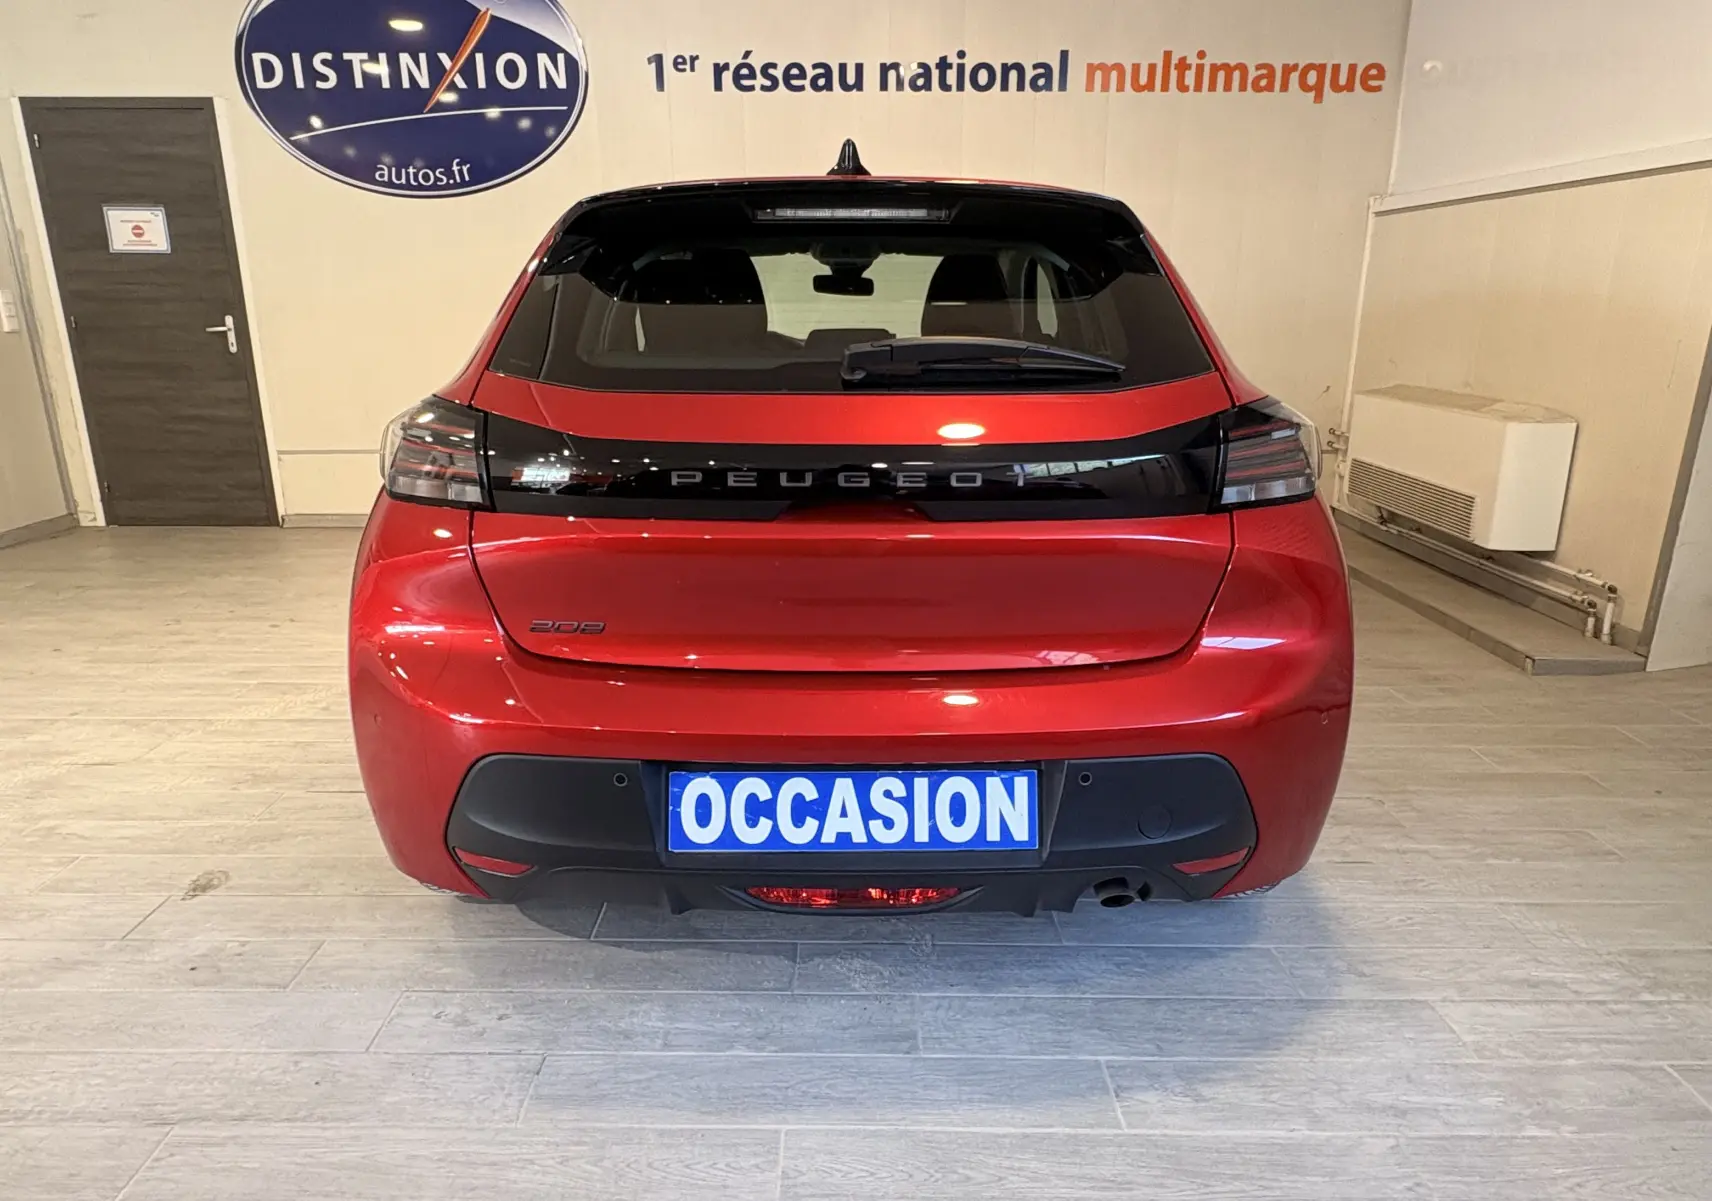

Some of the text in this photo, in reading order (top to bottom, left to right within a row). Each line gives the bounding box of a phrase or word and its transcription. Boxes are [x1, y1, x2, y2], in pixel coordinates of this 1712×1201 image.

[251, 51, 568, 90] DISTINXION
[646, 49, 1387, 104] 1er réseau national multimarque
[374, 158, 471, 187] autos.fr
[670, 471, 1033, 488] PEUGEOT
[529, 619, 605, 635] 208
[679, 775, 1030, 845] OCCASION
